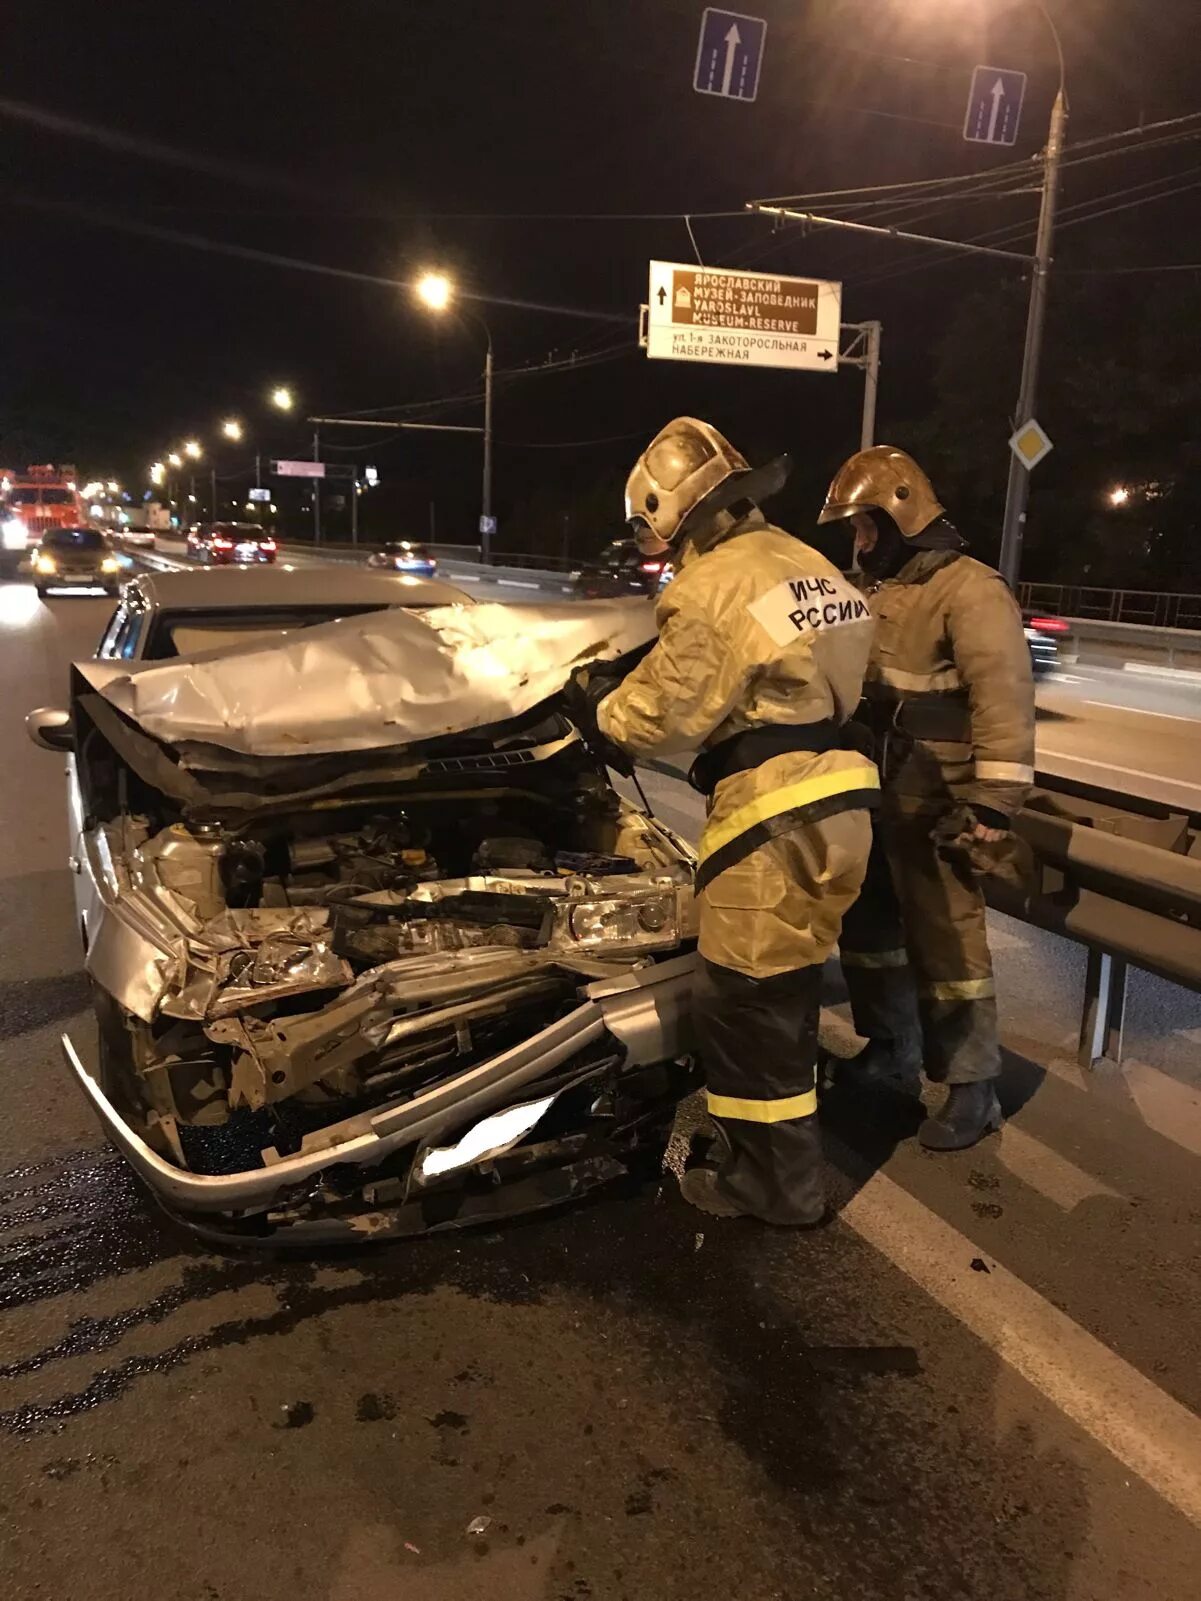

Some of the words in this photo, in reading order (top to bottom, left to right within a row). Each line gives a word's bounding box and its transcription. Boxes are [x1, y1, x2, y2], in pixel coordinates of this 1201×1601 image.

[693, 273, 781, 293] ЯРОСЛАВСКИЙ
[693, 300, 761, 317] YAROSLAVL
[692, 313, 799, 332] MUSEUM-RESERVE
[672, 344, 749, 361] НАБЕРЕЖНАЯ
[708, 336, 807, 352] ЗАКОТОРОСЛЬНАЯ
